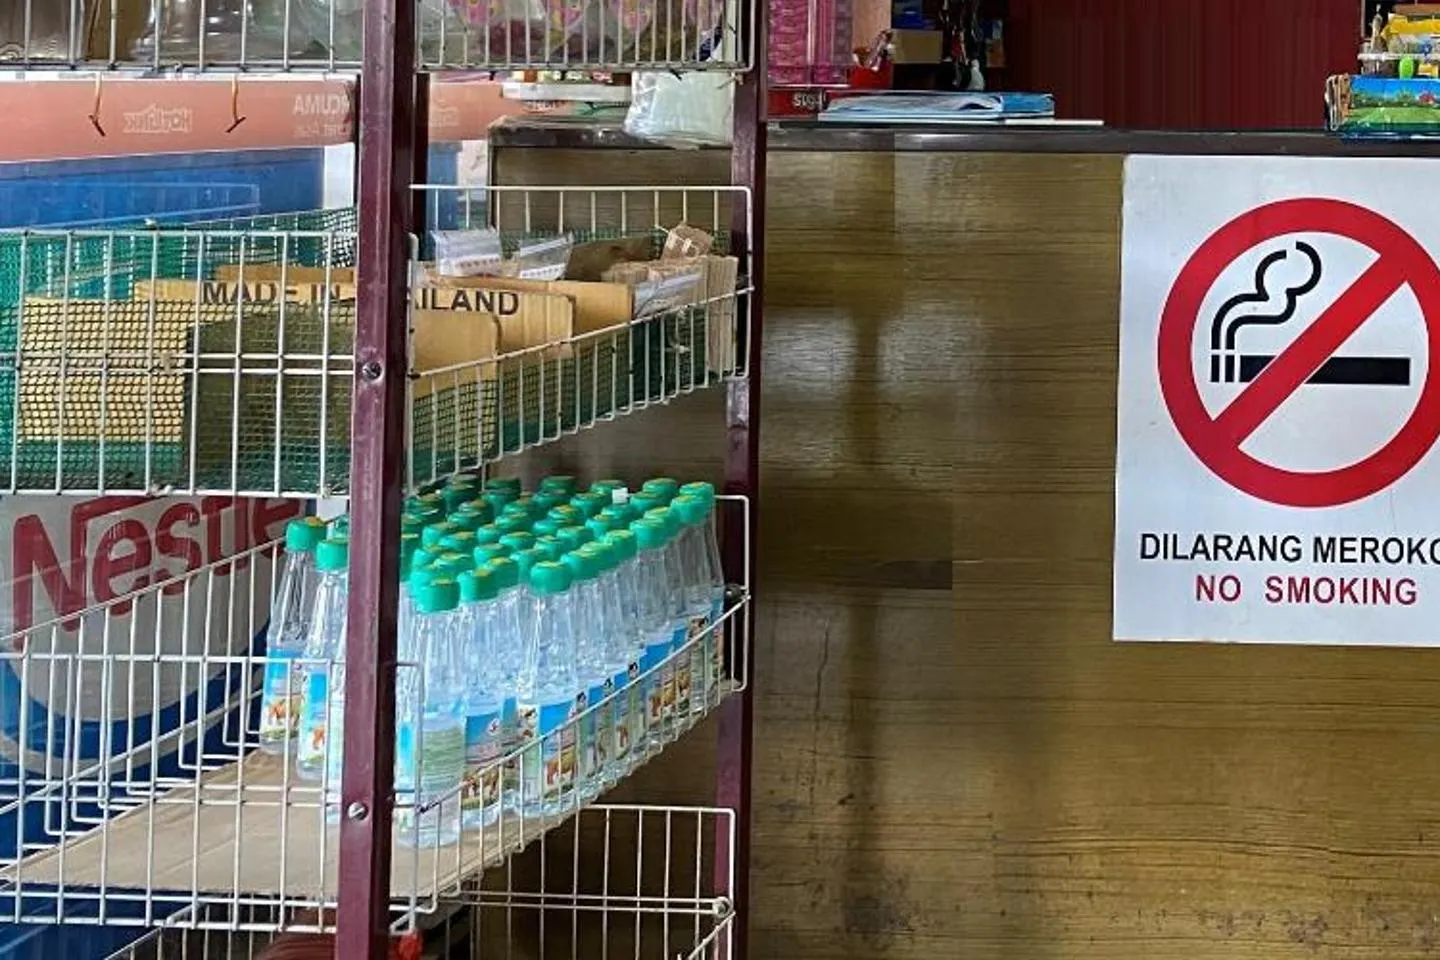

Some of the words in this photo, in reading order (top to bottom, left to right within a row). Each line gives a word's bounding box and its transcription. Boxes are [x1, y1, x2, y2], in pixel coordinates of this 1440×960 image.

[201, 281, 298, 306] MADE
[311, 283, 342, 305] IN
[1140, 533, 1302, 563] DILARANG
[1196, 574, 1242, 602] NO
[1264, 576, 1417, 606] SMOKING
